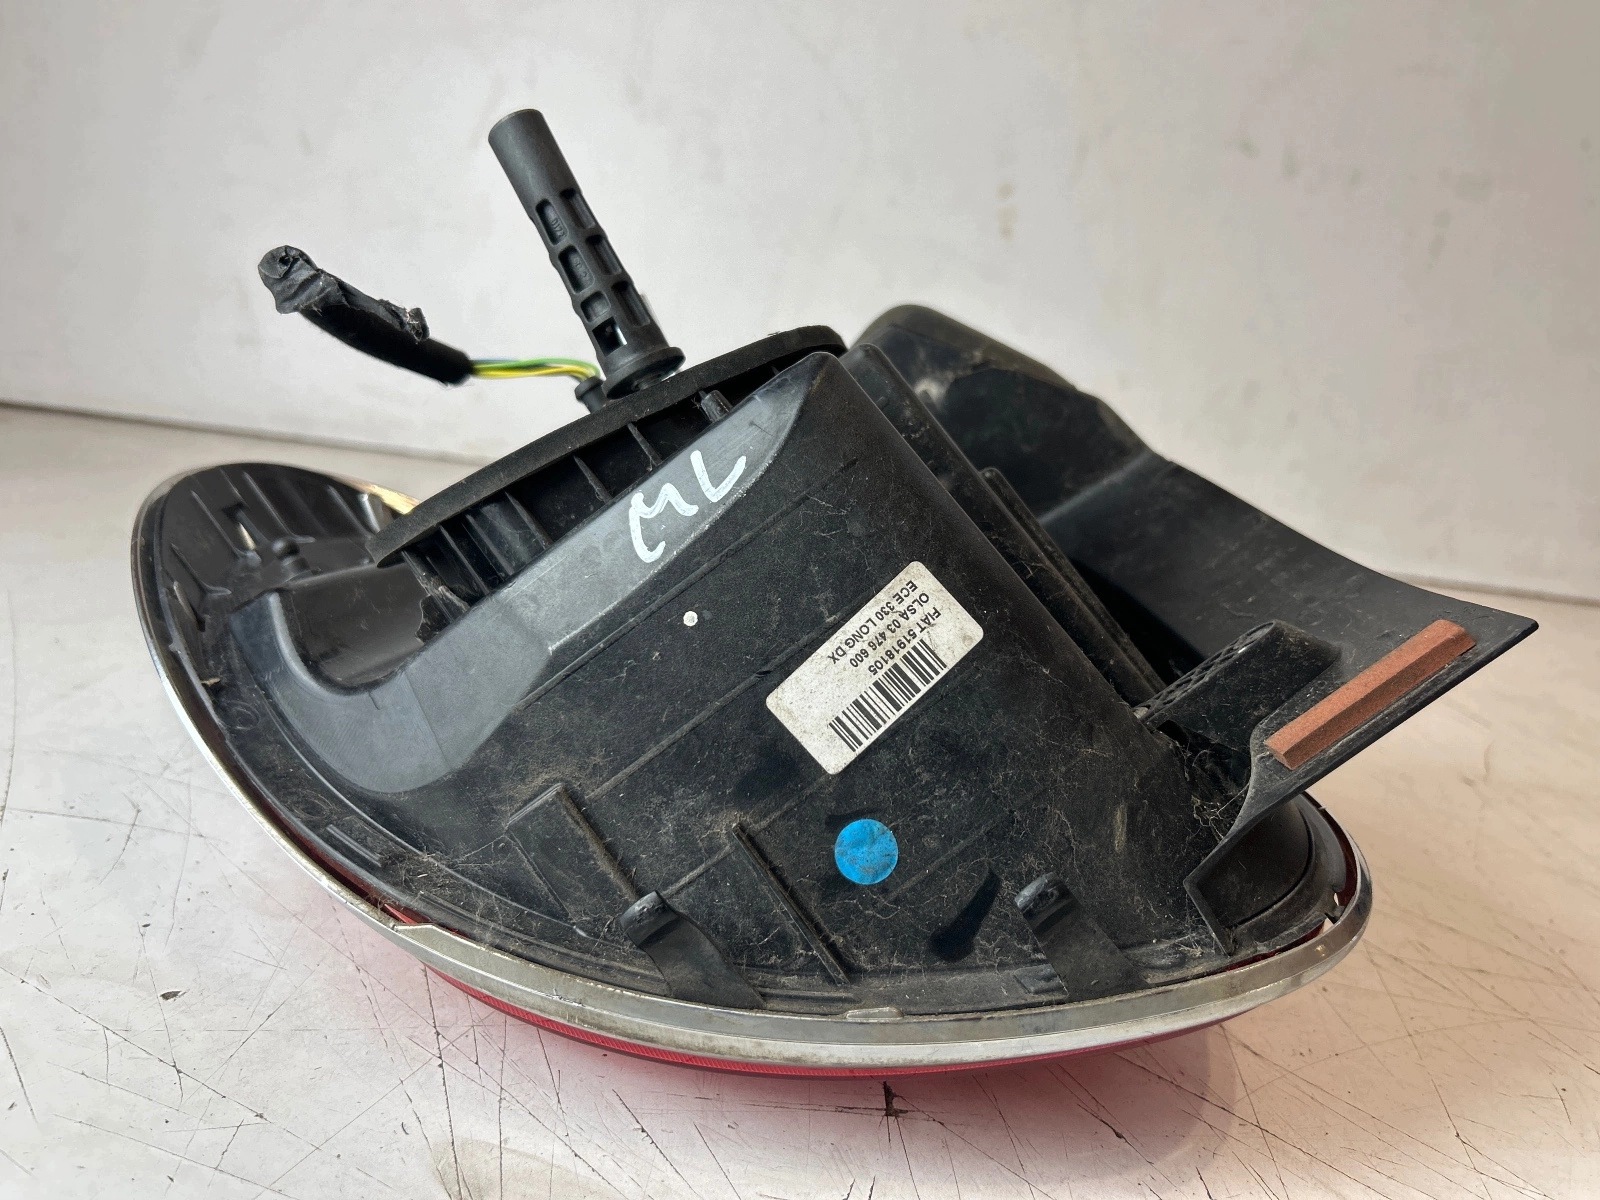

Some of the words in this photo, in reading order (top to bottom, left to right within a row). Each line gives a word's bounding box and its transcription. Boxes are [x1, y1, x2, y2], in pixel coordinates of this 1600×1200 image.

[892, 580, 918, 605] ECE
[878, 601, 895, 621] 330
[899, 592, 930, 621] OLSA
[886, 618, 902, 634] 03
[916, 606, 942, 633] FIAT
[844, 617, 877, 648] LONG
[867, 631, 887, 651] 476
[827, 646, 847, 664] DX
[849, 646, 870, 668] 600
[868, 628, 918, 676] 51918105
